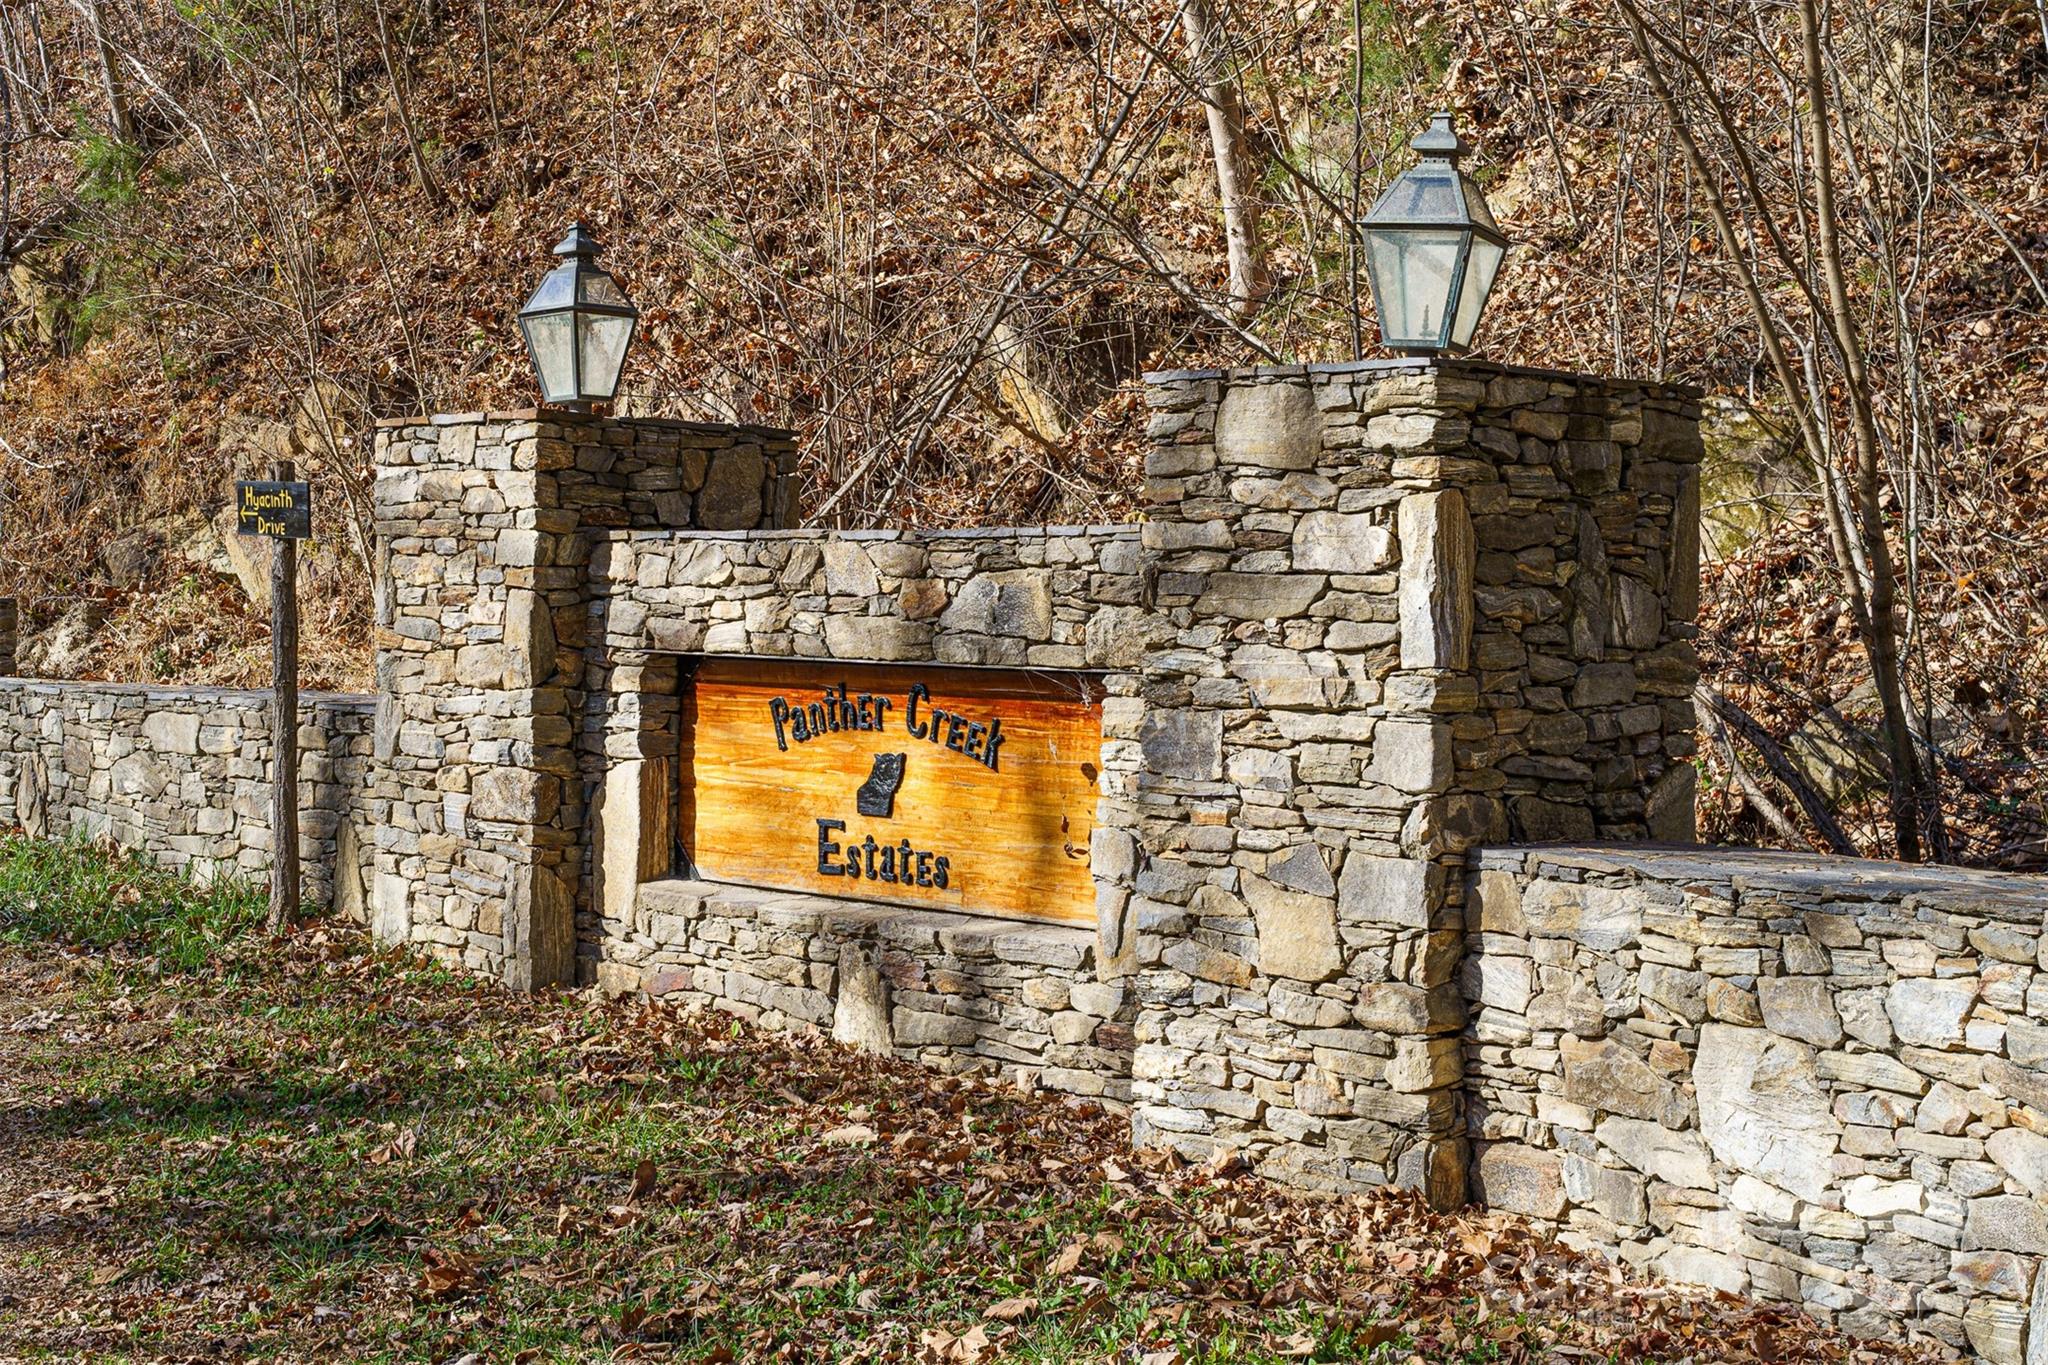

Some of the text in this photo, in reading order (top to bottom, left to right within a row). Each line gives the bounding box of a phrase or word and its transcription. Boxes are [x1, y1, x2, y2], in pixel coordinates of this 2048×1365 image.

[245, 486, 293, 511] Hyacinth
[257, 516, 286, 536] Drive
[768, 682, 1005, 773] Panther Creek
[816, 818, 951, 889] Estates
